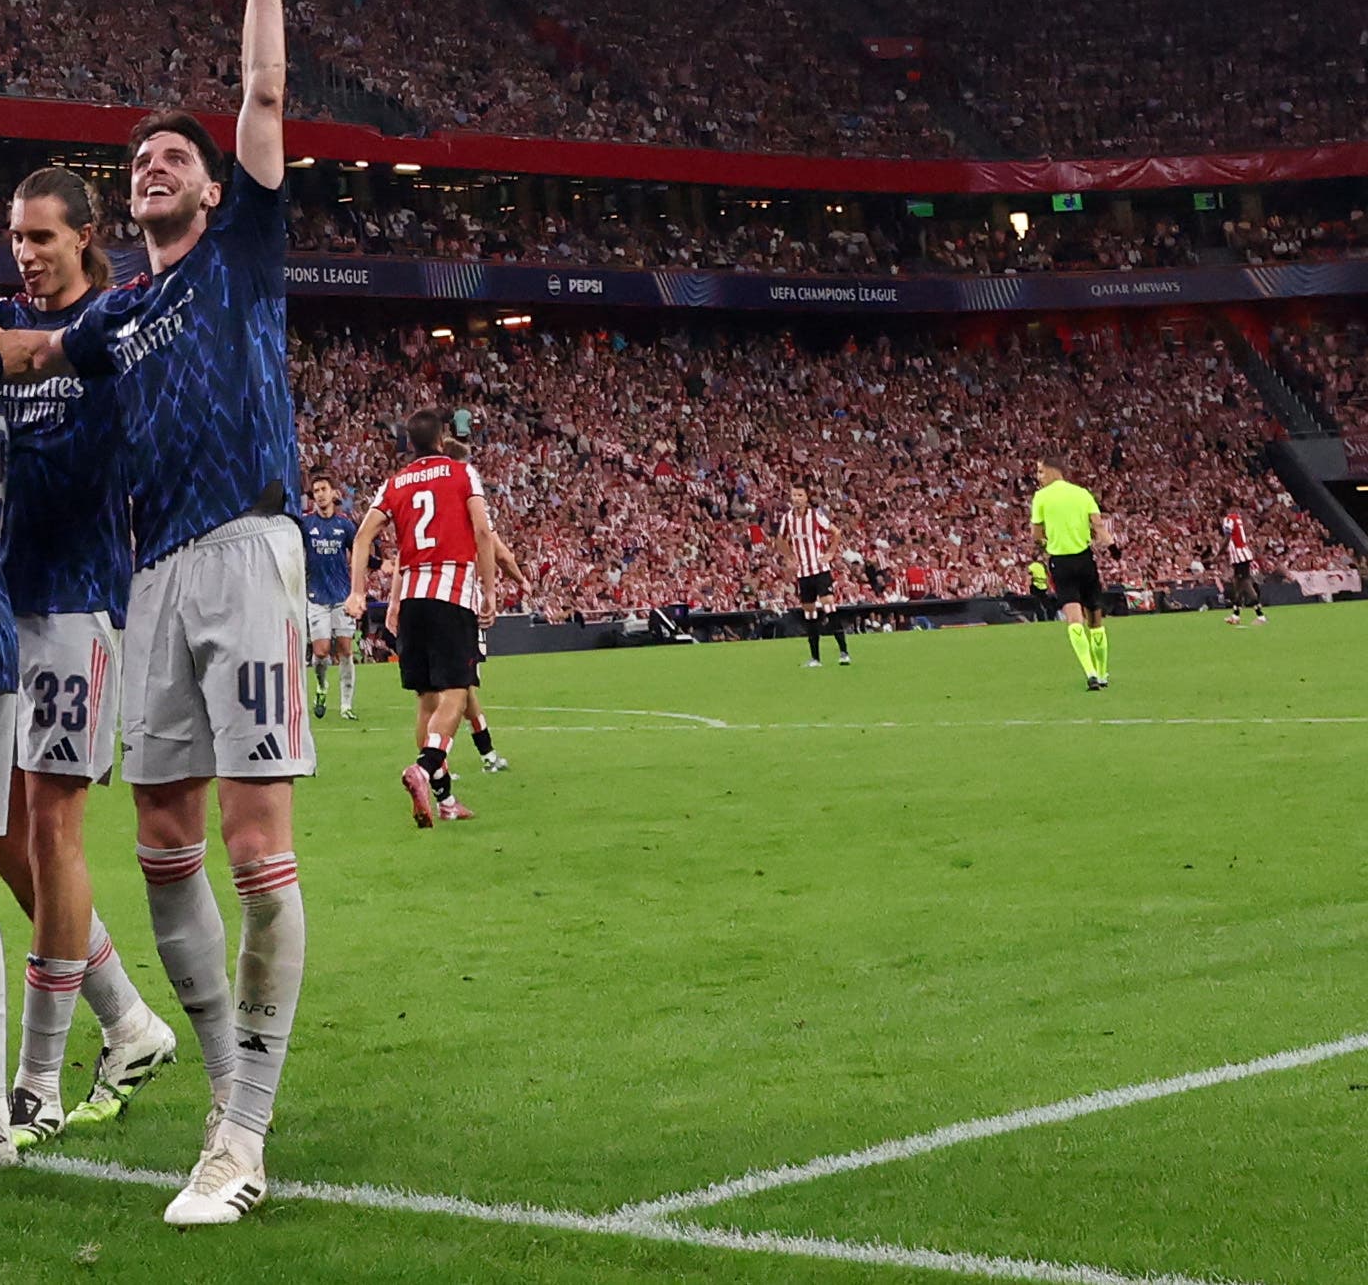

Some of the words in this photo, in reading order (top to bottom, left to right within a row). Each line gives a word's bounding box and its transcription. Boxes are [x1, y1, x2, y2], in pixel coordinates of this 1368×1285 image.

[284, 267, 319, 283] PIONS
[323, 268, 369, 284] LEAGUE
[569, 278, 603, 294] PEPSI
[770, 287, 797, 300] UEFA
[798, 287, 856, 302] CHAMPIONS
[859, 287, 898, 302] LEAGUE
[1091, 283, 1129, 297] QATAR
[1133, 280, 1181, 294] AIRWAYS
[395, 465, 451, 489] GOROSABEL
[412, 490, 436, 550] 2
[35, 671, 89, 732] 33
[238, 661, 284, 725] 41
[238, 1000, 277, 1017] AFC
